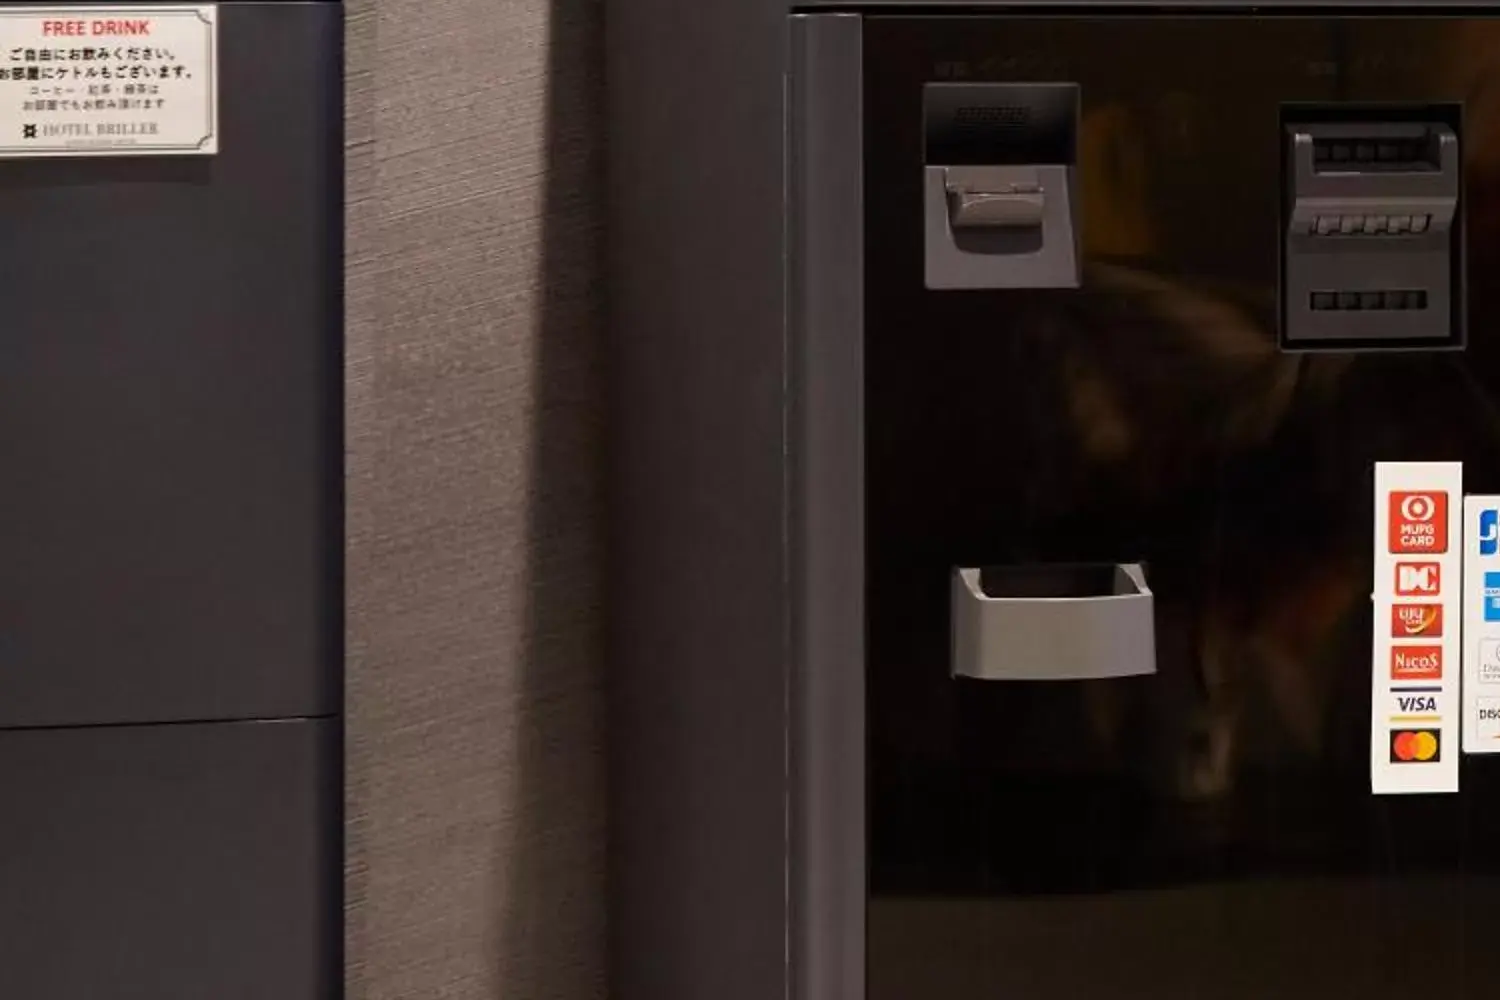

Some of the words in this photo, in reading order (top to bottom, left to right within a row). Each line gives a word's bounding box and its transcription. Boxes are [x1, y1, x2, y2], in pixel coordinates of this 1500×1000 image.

[42, 20, 87, 36] FREE
[92, 19, 151, 36] DRINK
[9, 47, 176, 62] ご自由にお飲みください。
[1400, 535, 1435, 546] CARD
[1399, 565, 1437, 591] DC
[1397, 697, 1437, 712] VISA
